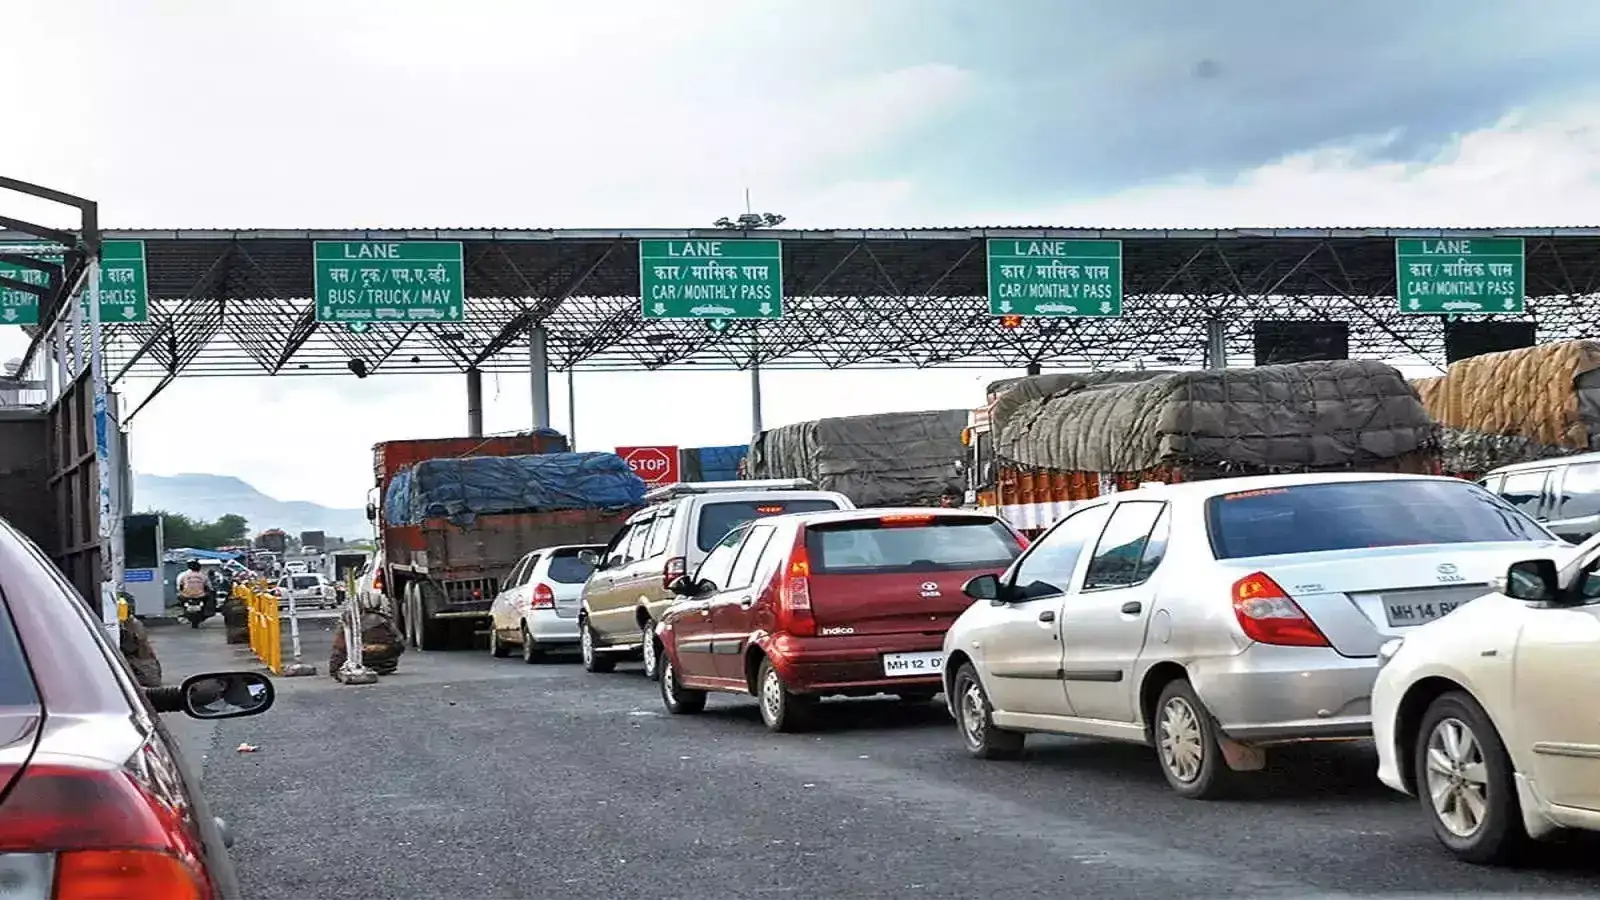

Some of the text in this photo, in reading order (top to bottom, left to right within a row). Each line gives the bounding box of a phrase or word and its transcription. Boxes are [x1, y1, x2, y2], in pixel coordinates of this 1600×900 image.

[344, 243, 400, 258] LANE
[668, 242, 723, 256] LANE
[1015, 241, 1067, 256] LANE
[1422, 240, 1472, 254] LANE
[741, 265, 769, 281] पास
[1084, 265, 1110, 280] पास
[1487, 263, 1513, 278] पास
[741, 284, 772, 300] PASS
[1083, 283, 1112, 299] PASS
[1487, 281, 1516, 296] PASS
[100, 289, 137, 305] EHICLES
[629, 459, 666, 471] STOP
[1390, 604, 1415, 620] MH
[1416, 603, 1436, 618] 14
[887, 657, 943, 671] MH 12 D
